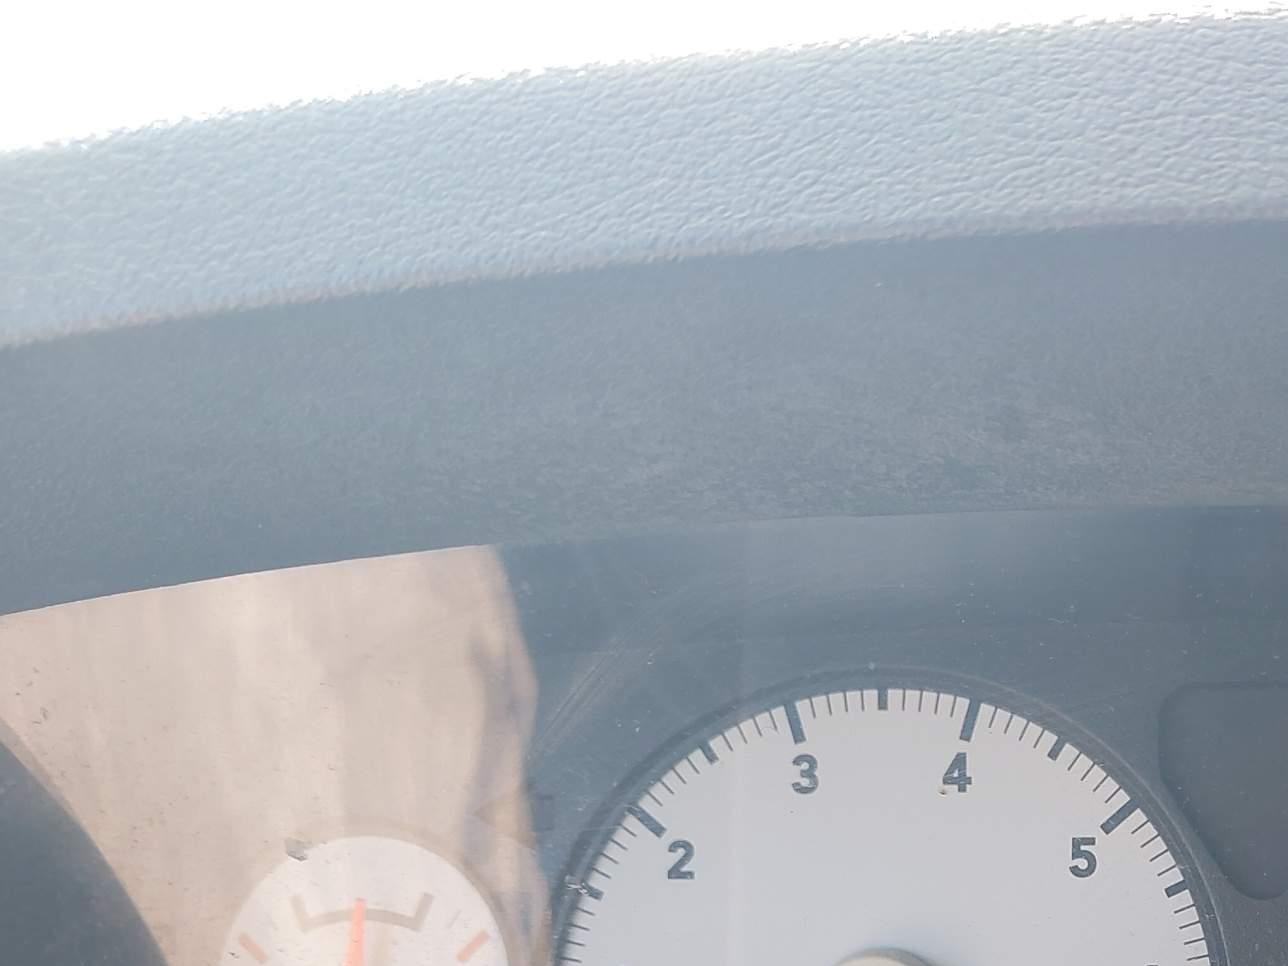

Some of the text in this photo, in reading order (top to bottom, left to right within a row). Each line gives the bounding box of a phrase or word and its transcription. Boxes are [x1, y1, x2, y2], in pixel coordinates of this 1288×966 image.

[791, 754, 819, 794] 3
[942, 753, 972, 793] 4
[667, 841, 695, 879] 2
[1069, 838, 1097, 878] 5
